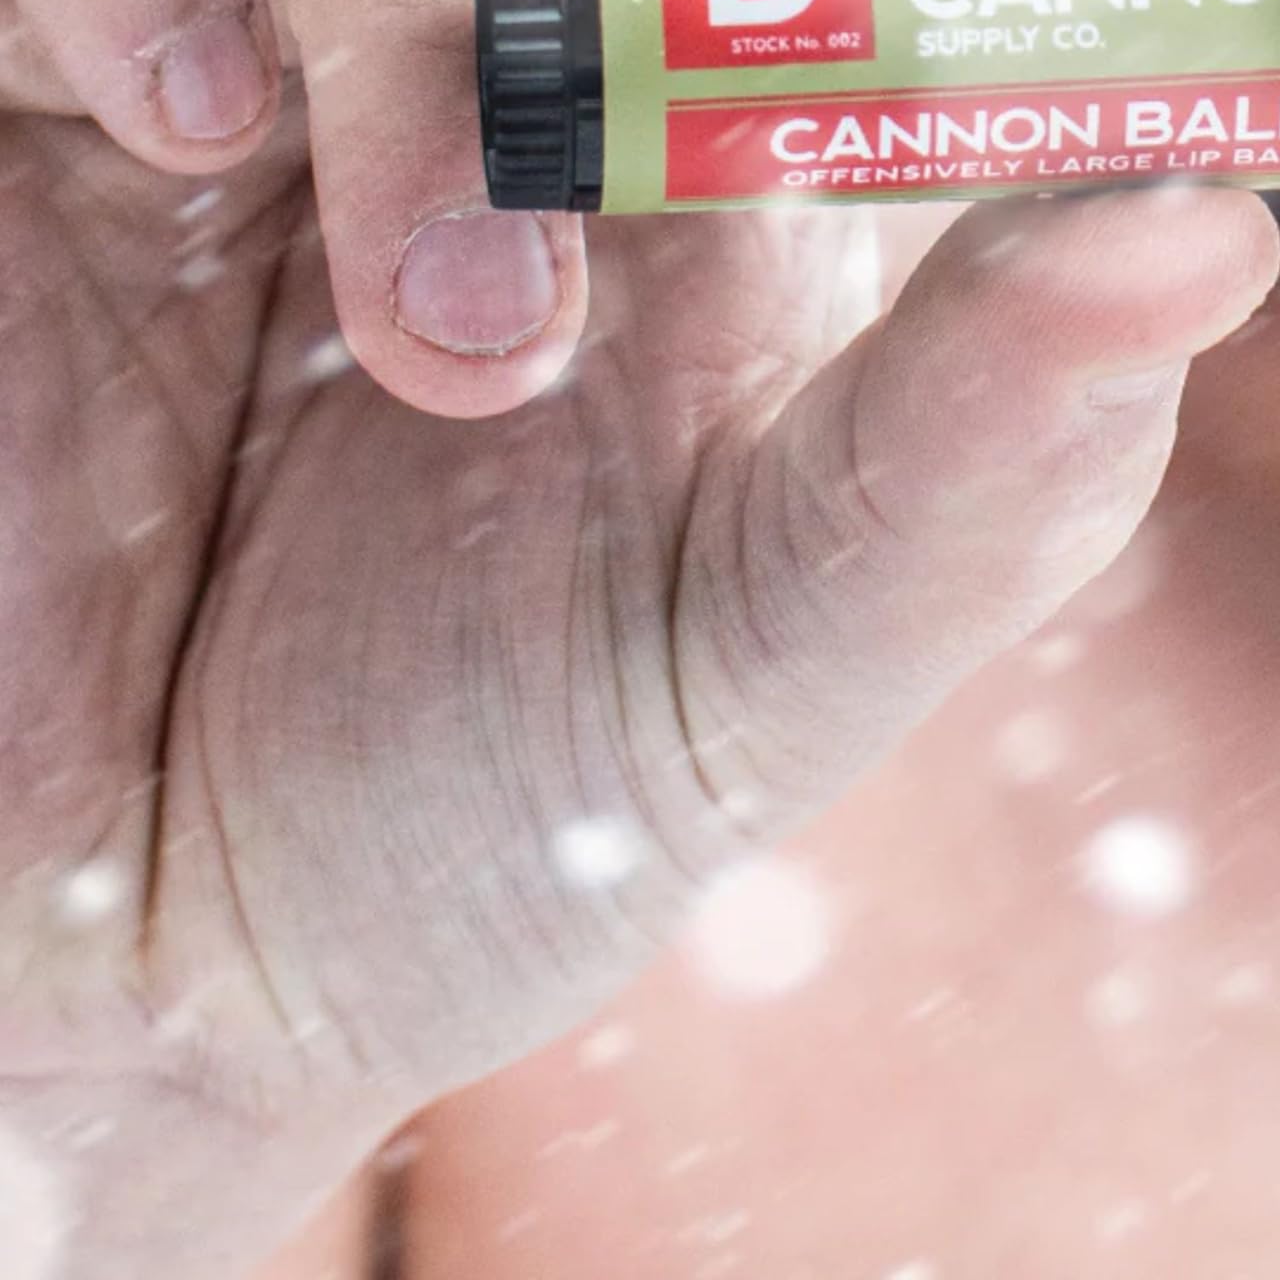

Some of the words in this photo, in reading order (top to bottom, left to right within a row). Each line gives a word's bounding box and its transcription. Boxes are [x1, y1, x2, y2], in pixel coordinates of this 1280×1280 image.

[731, 34, 790, 56] STOCK
[828, 31, 862, 50] 002
[917, 24, 1039, 58] SUPPLY
[1052, 22, 1105, 50] CO.
[769, 103, 1099, 163] CANNON
[782, 159, 1024, 187] OFFENSIVELY
[1037, 153, 1154, 174] LARGE
[1167, 150, 1222, 168] LIP
